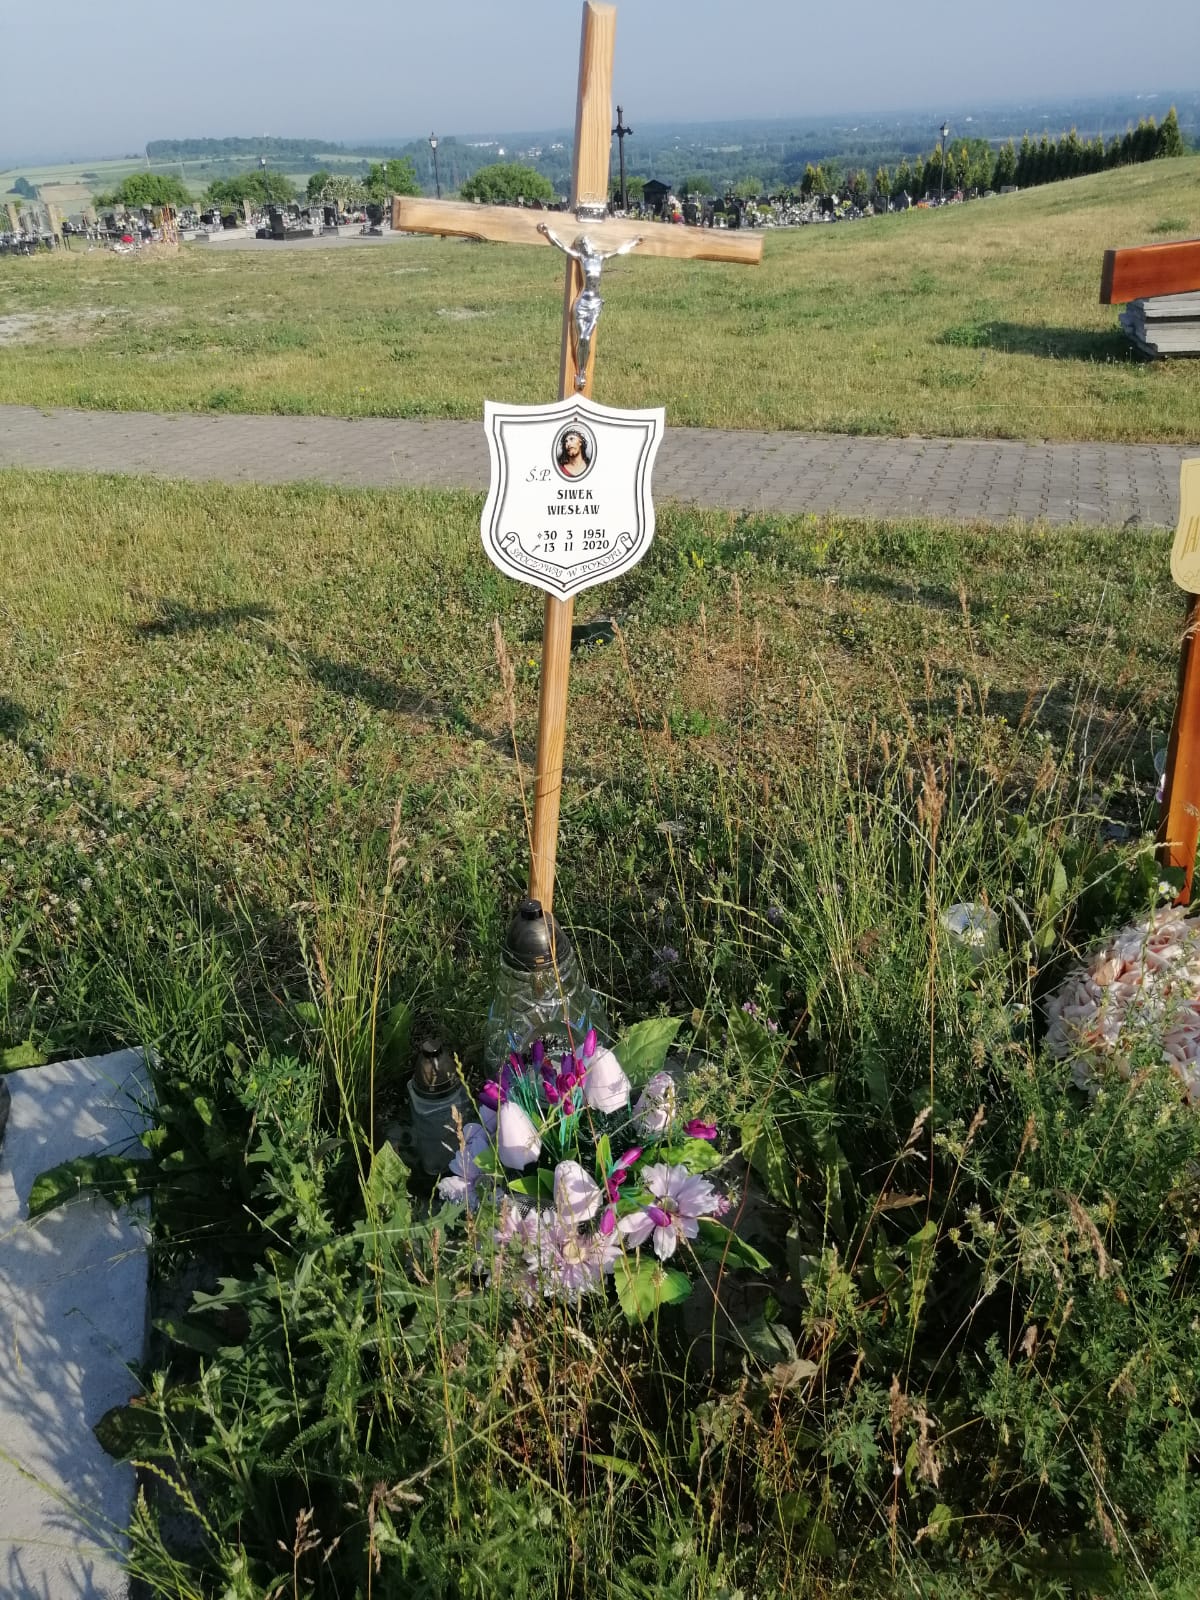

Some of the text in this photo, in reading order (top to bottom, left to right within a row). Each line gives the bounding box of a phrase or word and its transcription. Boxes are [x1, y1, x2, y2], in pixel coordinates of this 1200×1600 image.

[556, 489, 593, 500] SIWEK
[547, 504, 600, 515] WIESŁAW
[543, 529, 605, 540] 30 3 1951
[544, 539, 609, 552] 13 11 2020
[510, 548, 622, 577] SPOCZYWAJ W POKOJU
